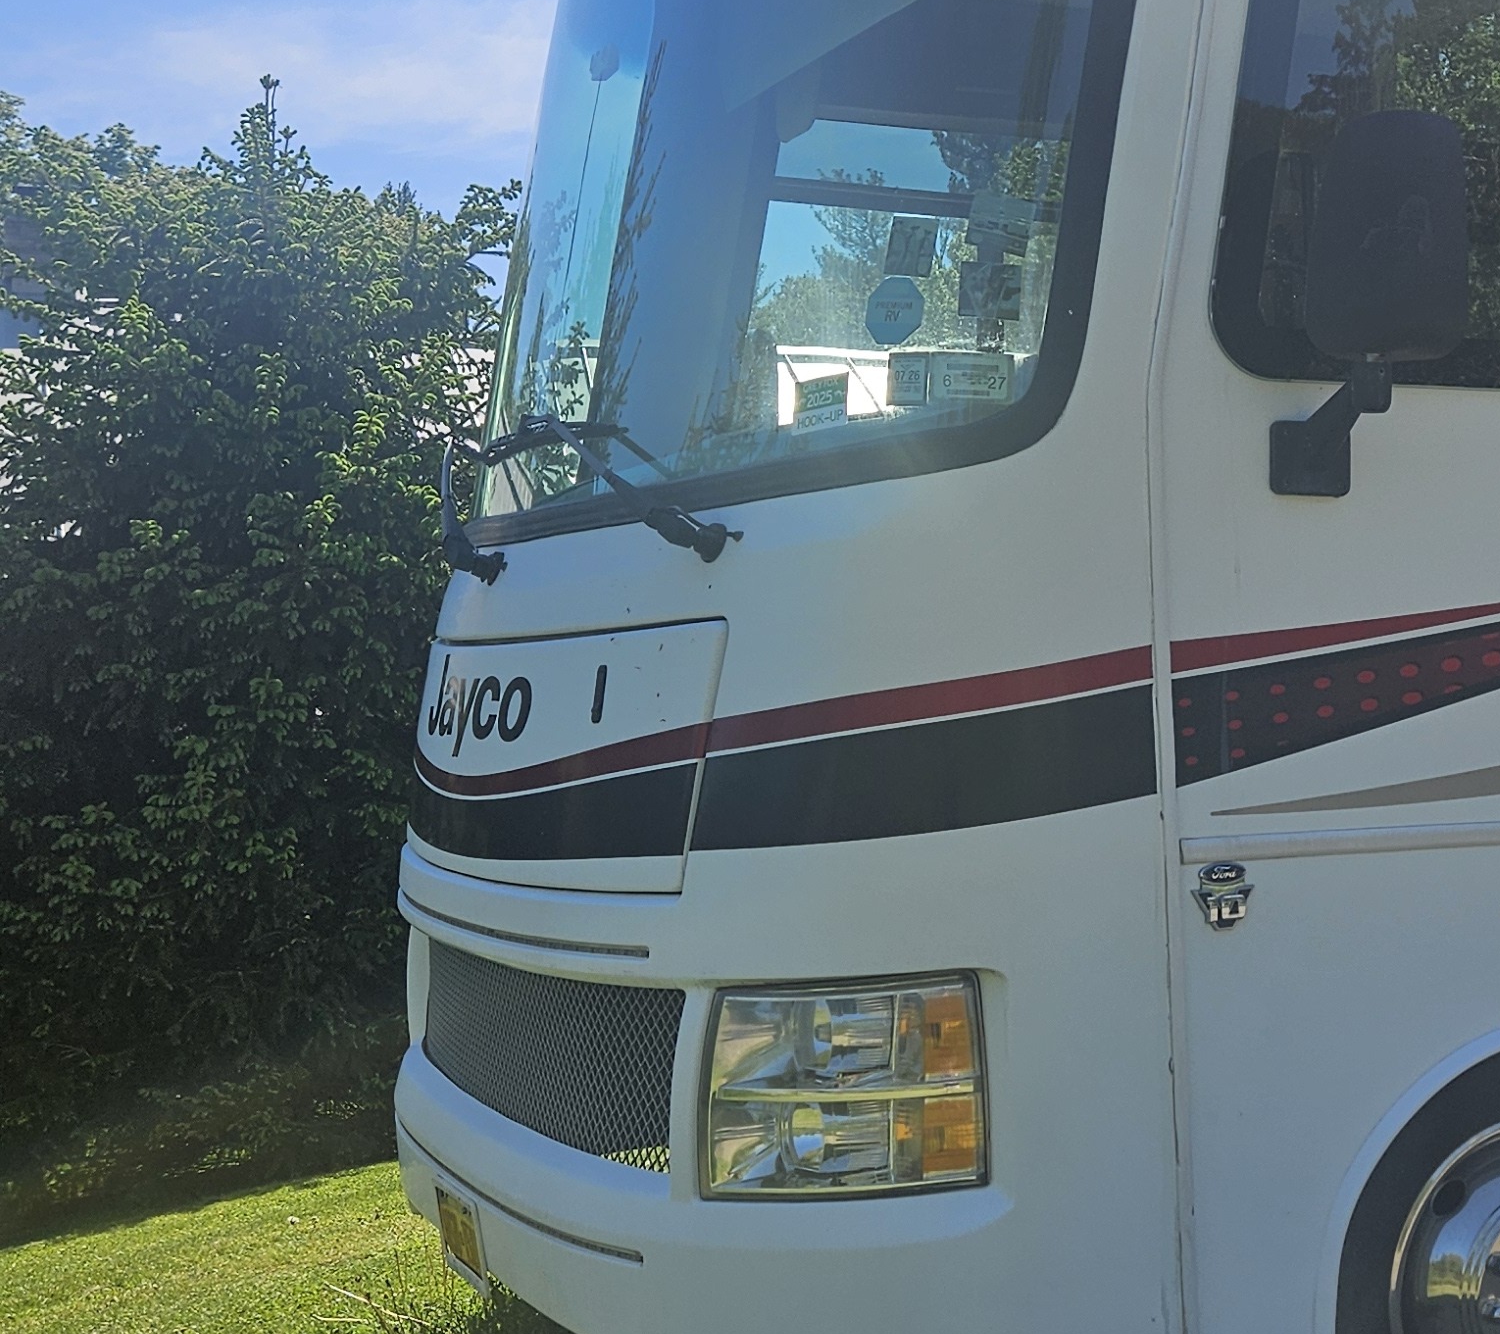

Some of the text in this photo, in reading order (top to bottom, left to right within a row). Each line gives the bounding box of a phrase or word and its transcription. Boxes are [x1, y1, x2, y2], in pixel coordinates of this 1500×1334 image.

[884, 310, 900, 322] RV
[943, 374, 952, 387] 6
[987, 376, 1007, 390] 27
[806, 389, 833, 408] 2025
[797, 409, 844, 430] HOOK-UP
[428, 654, 532, 757] Jayco
[1211, 866, 1238, 880] Ford
